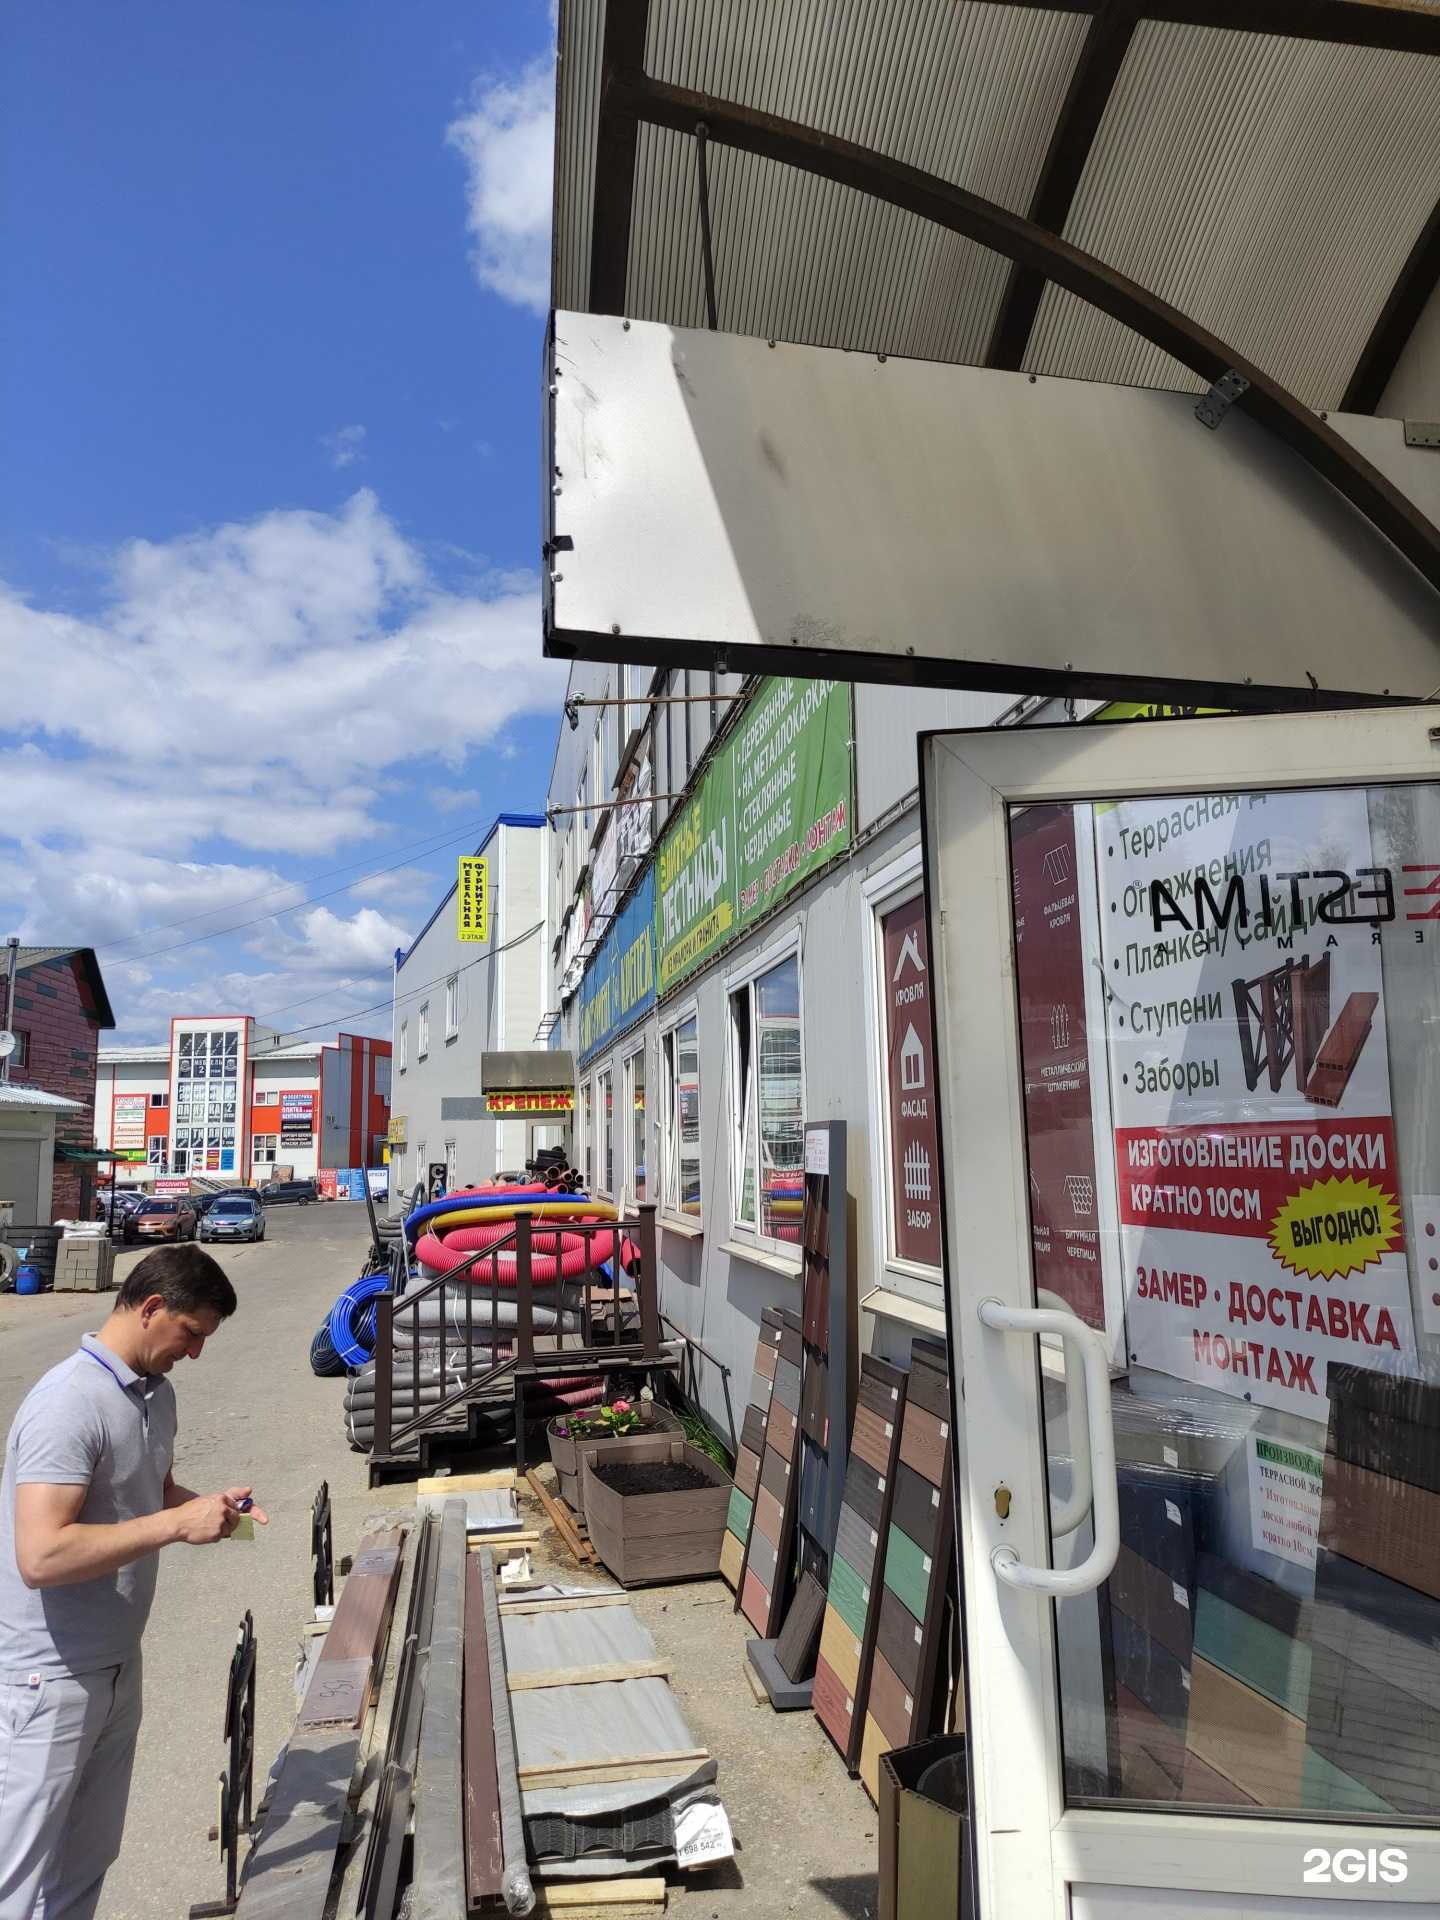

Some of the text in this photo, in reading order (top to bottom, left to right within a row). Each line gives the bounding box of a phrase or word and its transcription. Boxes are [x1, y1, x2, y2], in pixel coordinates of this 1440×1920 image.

[741, 676, 794, 768] ДЕРЕВЯННЫЕ
[742, 678, 839, 798] НА МЕТАЛЛОКАРКАС
[743, 750, 796, 832] СТЕКЛЯННЫЕ
[744, 798, 791, 864] ЧЕРДАЧНЫЕ
[806, 799, 847, 853] МОНТАЖ
[1119, 795, 1240, 861] Террасная
[463, 862, 473, 928] МЕБЕЛЬНАЯ
[474, 863, 485, 929] ФУРНИТУРА
[662, 816, 728, 948] ЛЕСТНИЦЫ
[1123, 838, 1272, 918] Огажения
[1043, 894, 1075, 916] ФАЛЬЦЕВАЯ
[1049, 913, 1071, 929] КРОВЛЯ
[698, 912, 720, 951] ГРАНИТА
[895, 982, 924, 1007] КРОВЛЯ
[1130, 991, 1223, 1036] Ступени
[1047, 1078, 1081, 1093] ШТАКЕТНИК
[1134, 1057, 1220, 1096] Заборы
[488, 1093, 572, 1111] КРЕПЕЖ
[901, 1098, 928, 1119] ФАСАД
[1128, 1133, 1387, 1175] ИЗГОТОВЛЕНИЕ ДОСКИ
[906, 1209, 931, 1230] ЗАБОР
[1130, 1183, 1262, 1221] КРАТНО 10СМ
[1065, 1231, 1096, 1243] БИТУМНАЯ
[1290, 1204, 1382, 1248] ВЫГОДНО!
[1066, 1245, 1097, 1262] ЧЕРЕПИЦА
[1136, 1266, 1401, 1351] ЗАМЕР ДОСТАВКА
[1193, 1328, 1319, 1396] МОНТАЖ
[1260, 1465, 1307, 1491] ТЕРРАСНОЙ
[700, 1841, 715, 1851] 542
